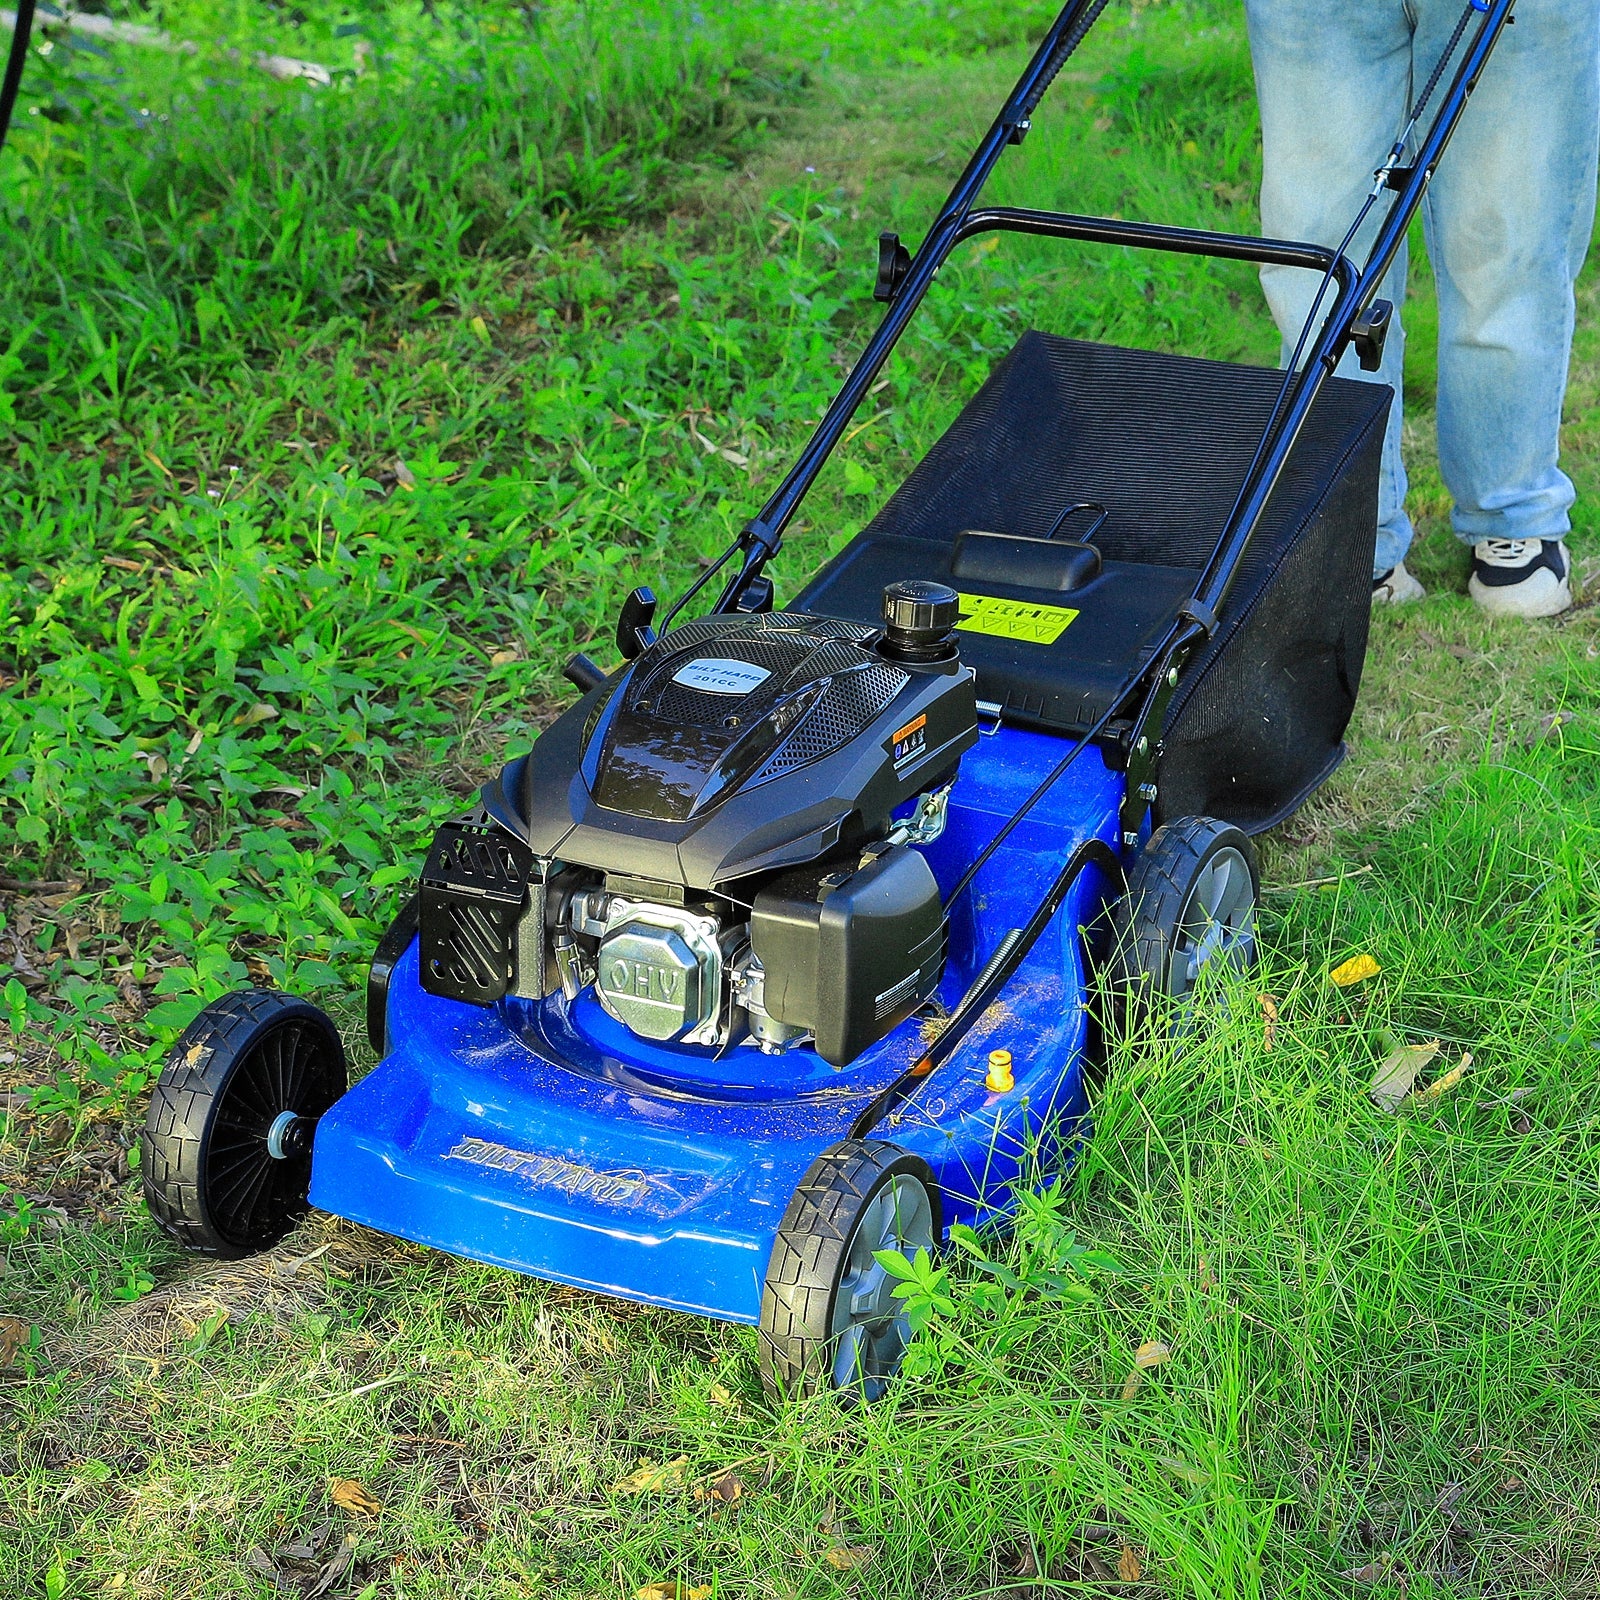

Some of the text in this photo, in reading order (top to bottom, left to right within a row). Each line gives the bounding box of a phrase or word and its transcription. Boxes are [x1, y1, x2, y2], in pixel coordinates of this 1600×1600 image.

[688, 665, 762, 681] BILT HARD
[693, 675, 737, 686] 201CC
[611, 959, 679, 1003] OHV
[452, 1138, 636, 1201] BILT HARD
